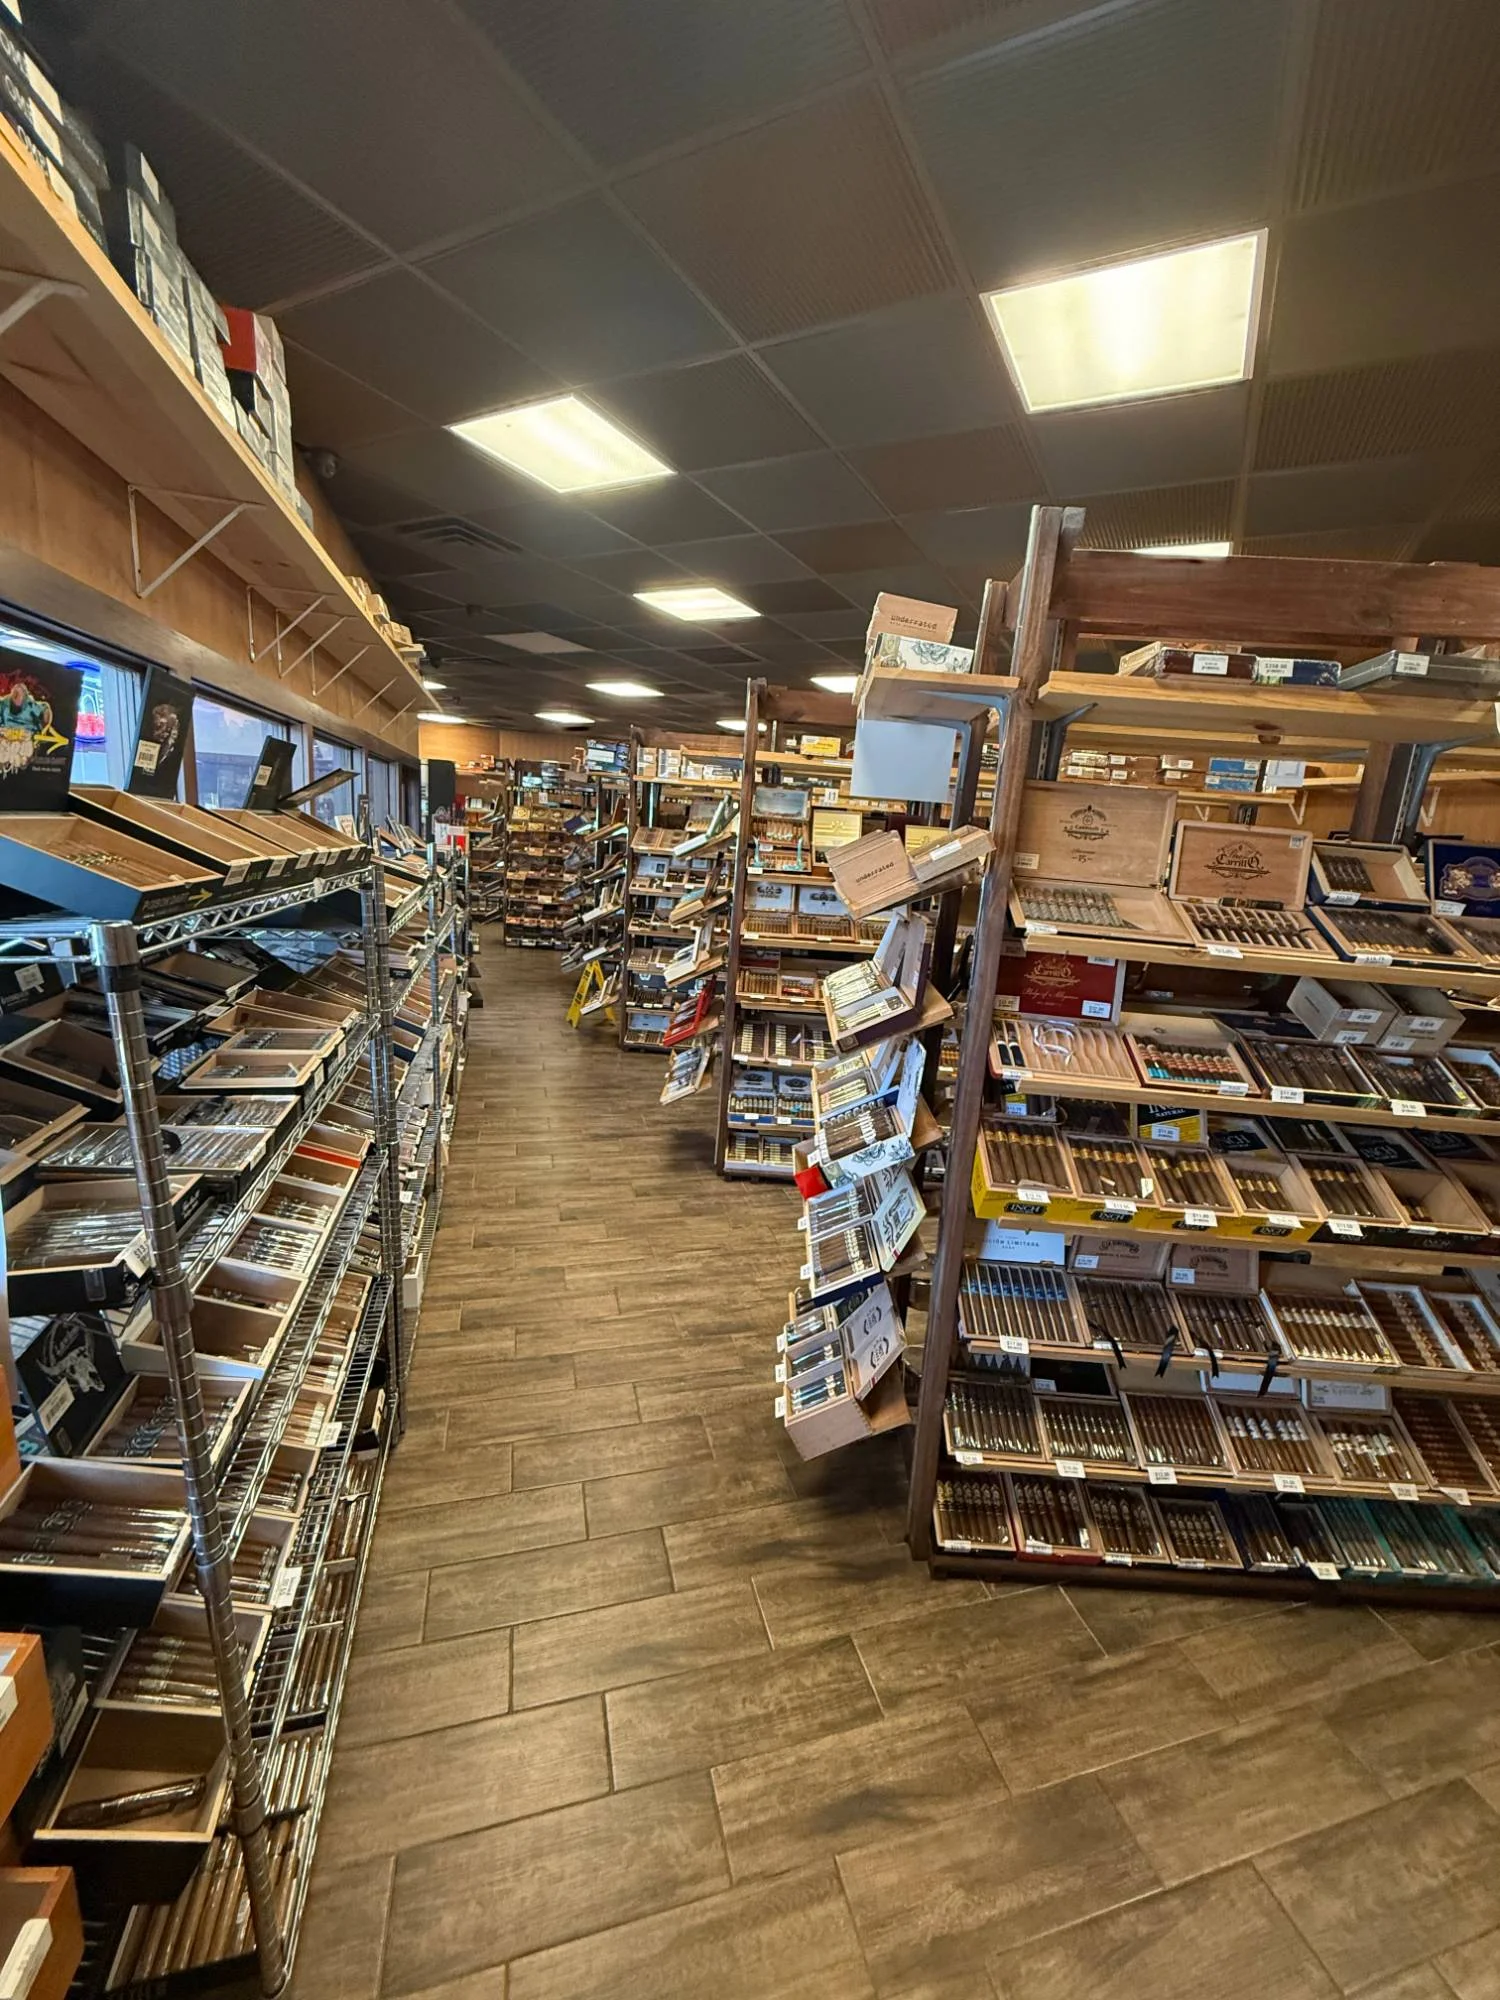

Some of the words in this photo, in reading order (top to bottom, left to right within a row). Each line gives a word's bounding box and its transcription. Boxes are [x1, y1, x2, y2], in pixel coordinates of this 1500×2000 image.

[890, 614, 938, 630] underrated
[855, 861, 895, 883] underrated
[1009, 1204, 1041, 1214] INCH
[1099, 1213, 1128, 1222] INCH
